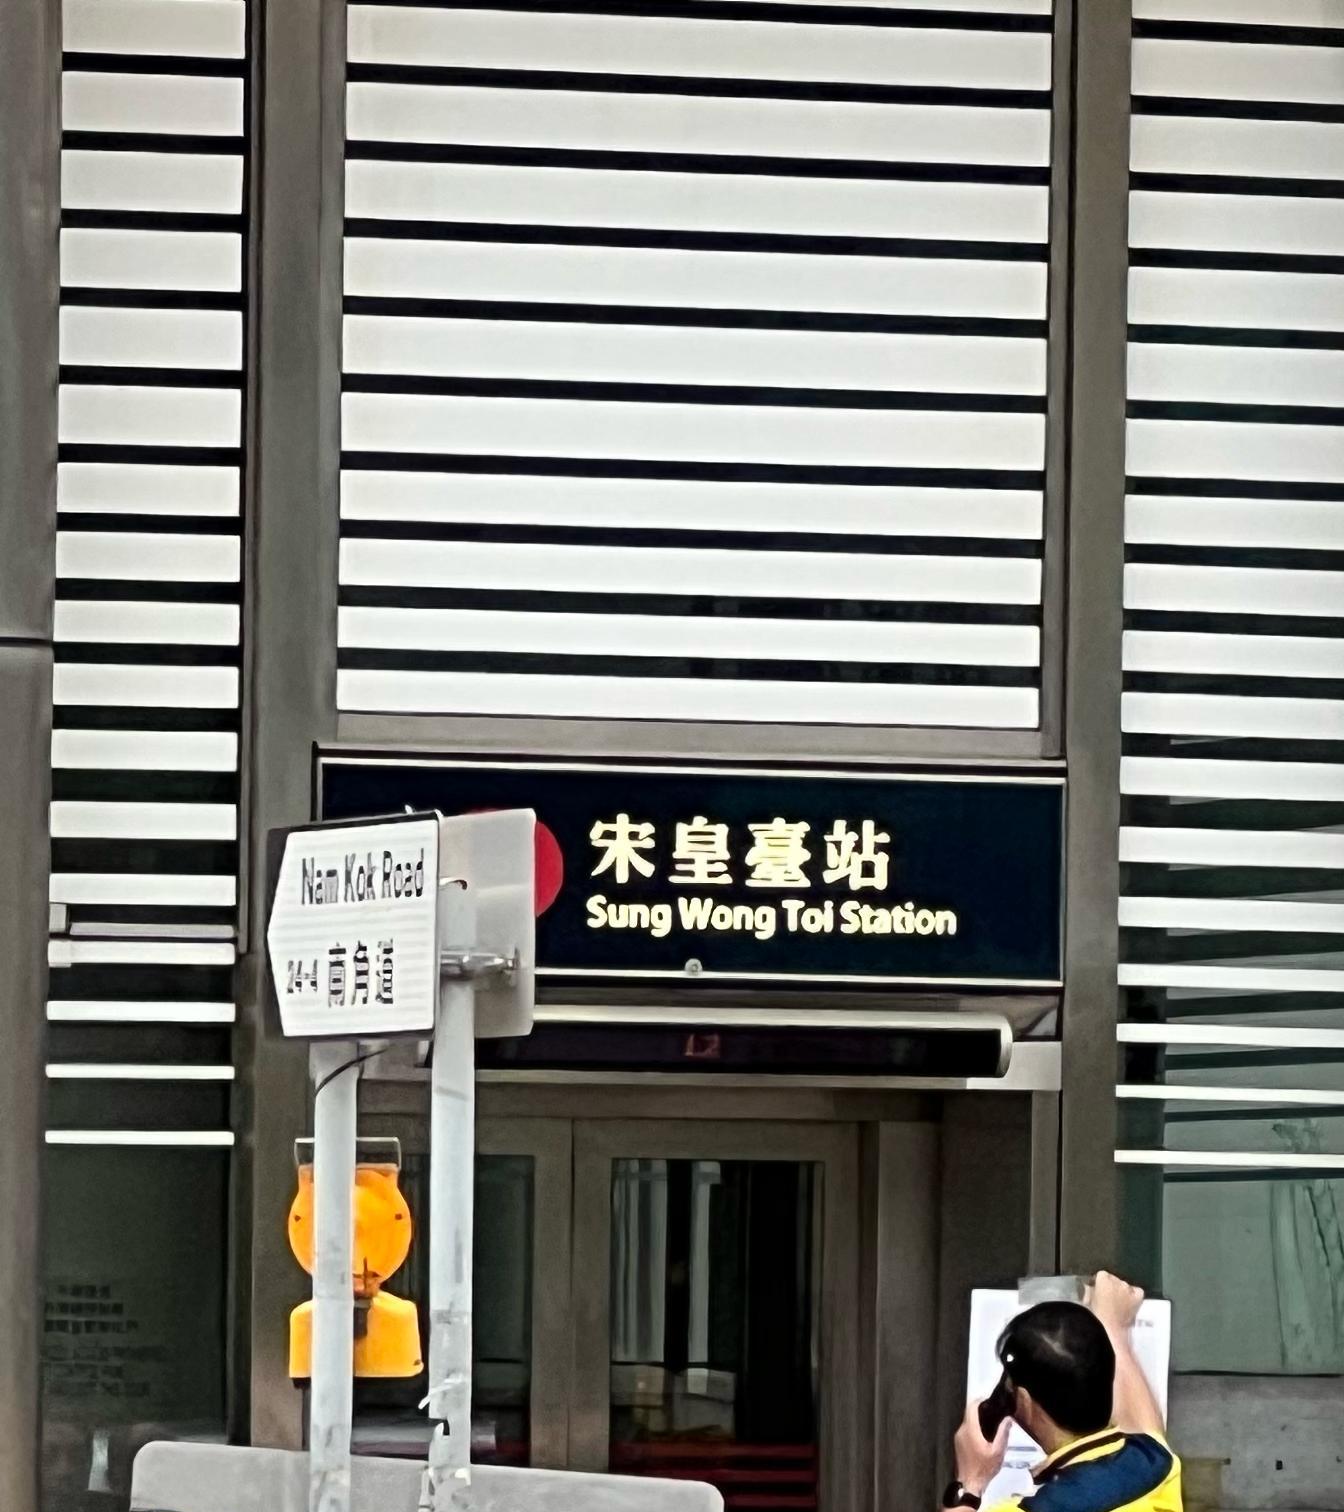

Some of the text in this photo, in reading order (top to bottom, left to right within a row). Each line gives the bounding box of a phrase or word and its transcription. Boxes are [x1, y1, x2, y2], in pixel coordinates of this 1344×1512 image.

[301, 847, 425, 906] Nam Kok Road
[589, 813, 891, 891] 宋皇臺站
[585, 894, 958, 941] Sung Wong Toi Station
